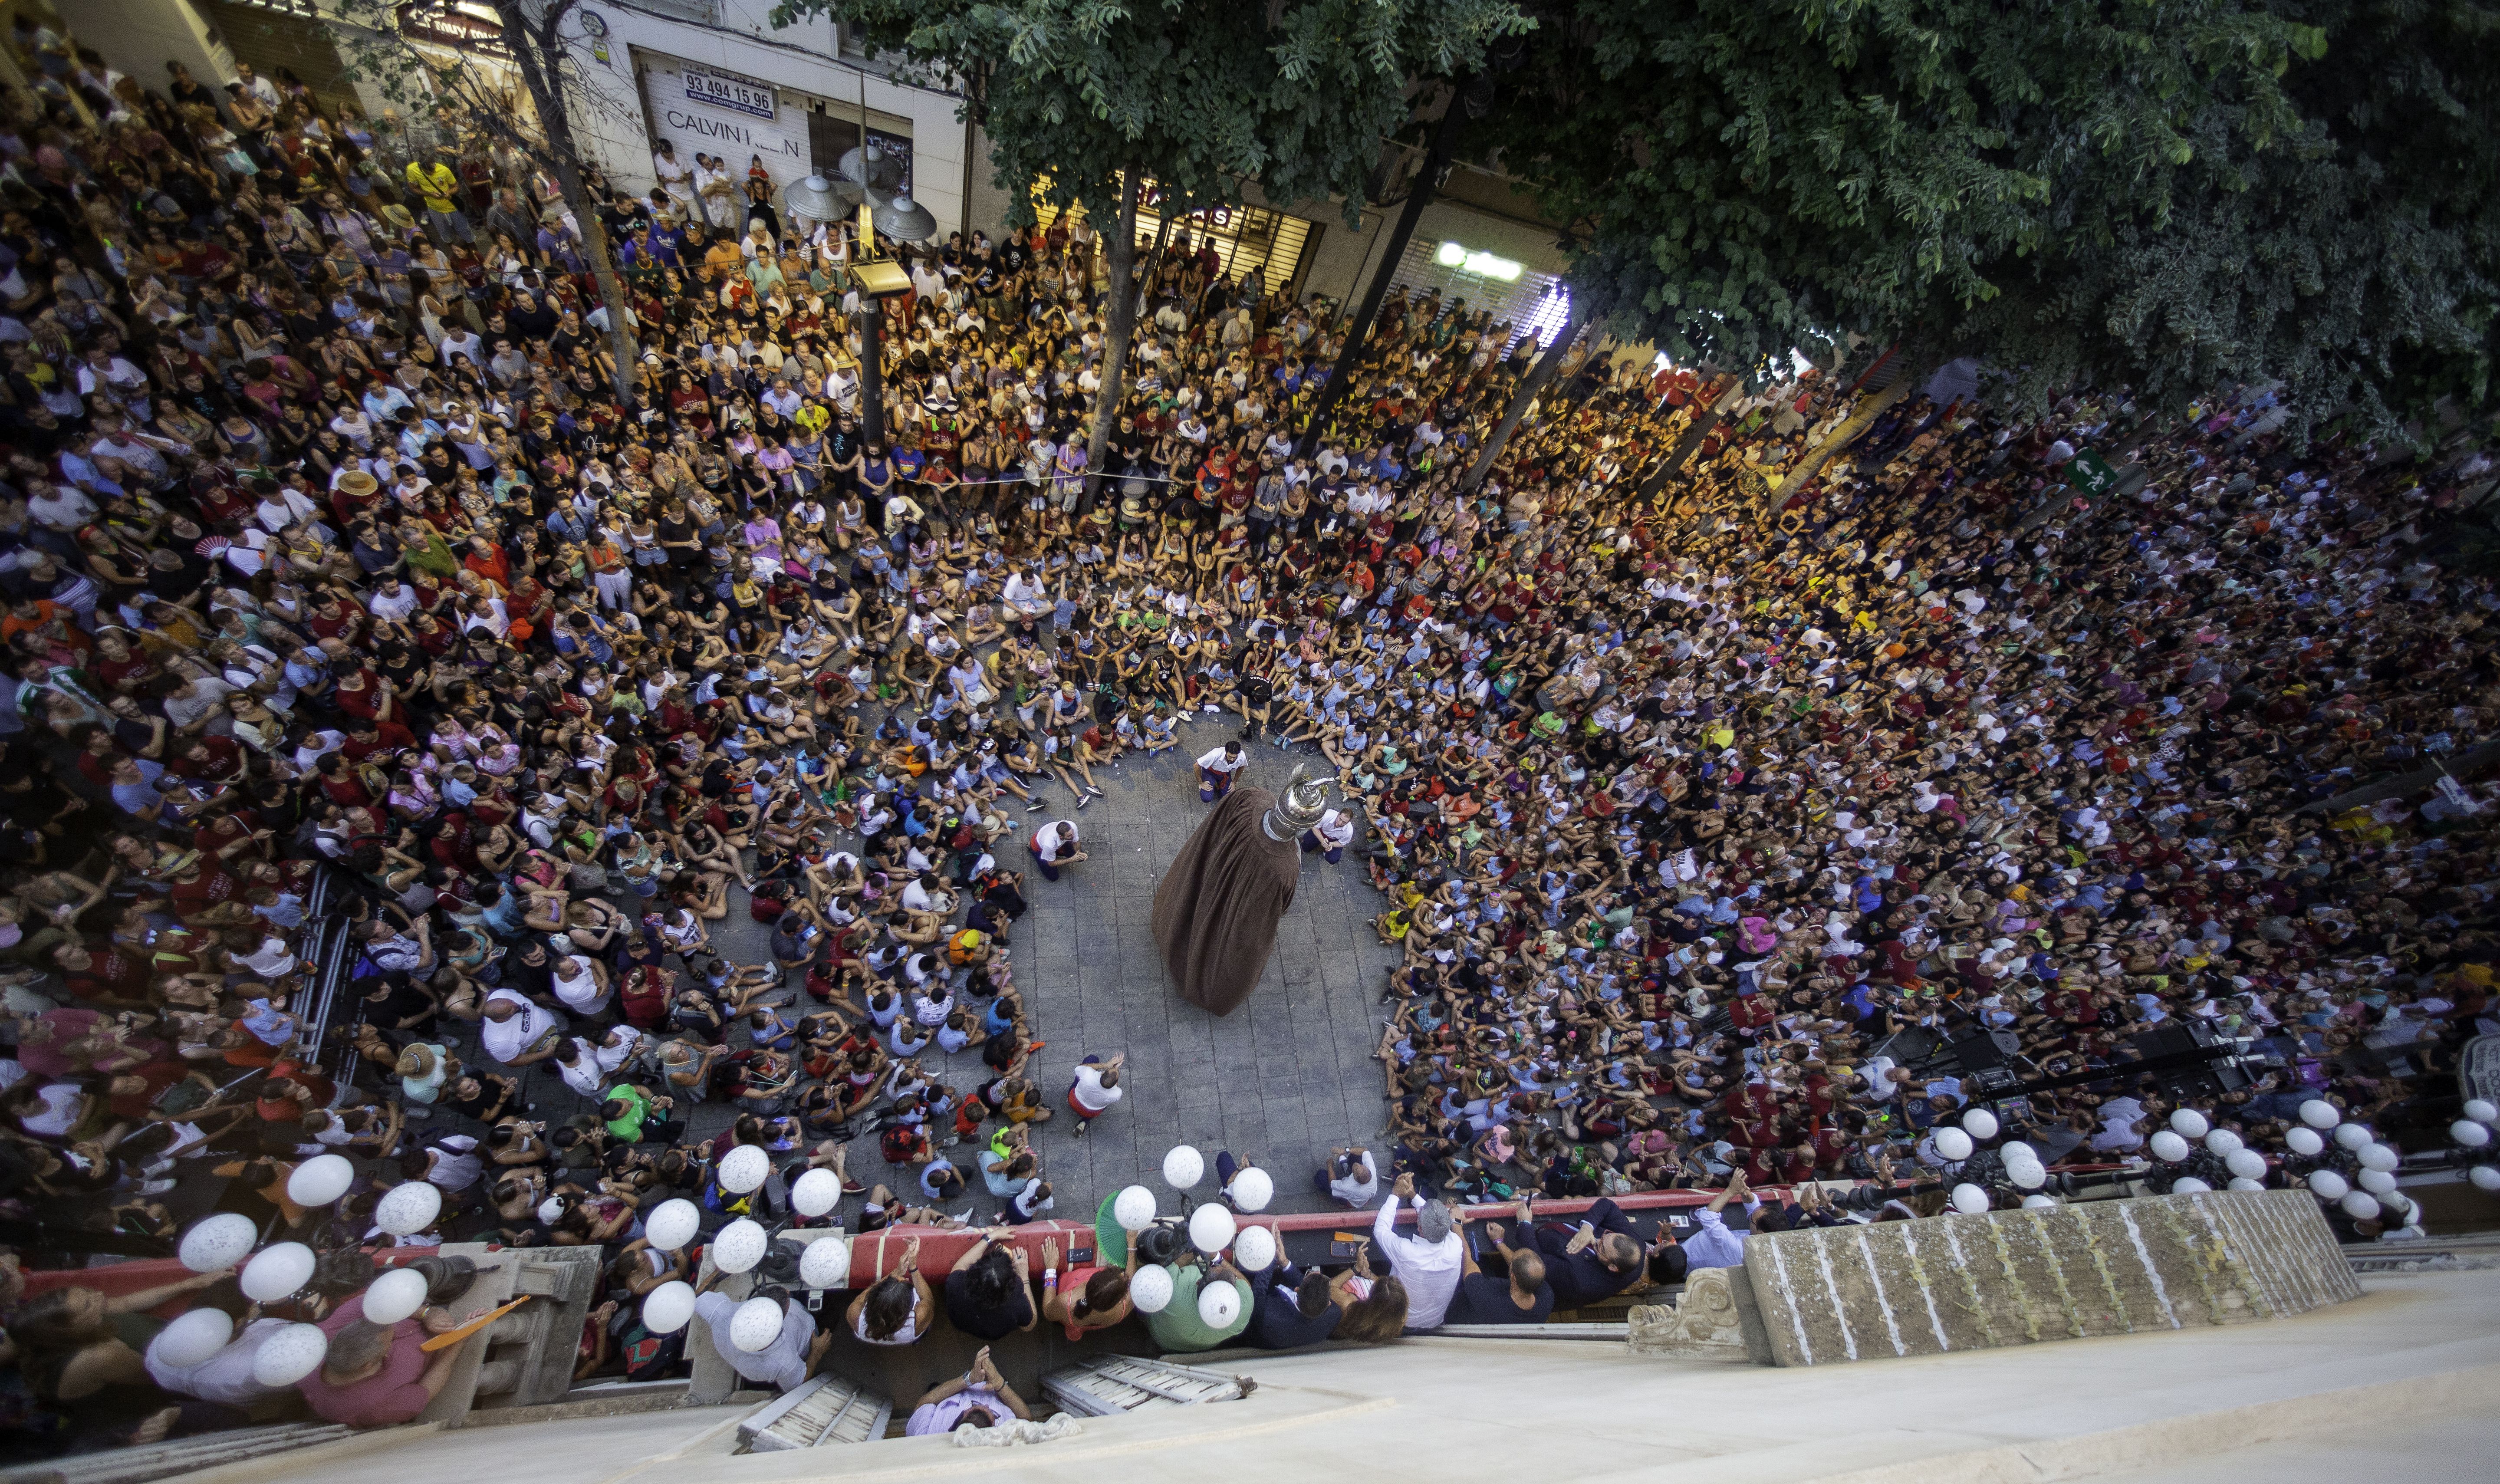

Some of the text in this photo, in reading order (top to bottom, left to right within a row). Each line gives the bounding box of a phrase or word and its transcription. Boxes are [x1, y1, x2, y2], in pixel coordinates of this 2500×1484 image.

[682, 68, 709, 78] COMGRUP
[687, 75, 703, 92] 93
[707, 80, 731, 99] 494
[734, 87, 750, 104] 15
[753, 92, 770, 109] 96
[689, 91, 771, 118] www.comgrup.com
[667, 110, 740, 143] CALVIN
